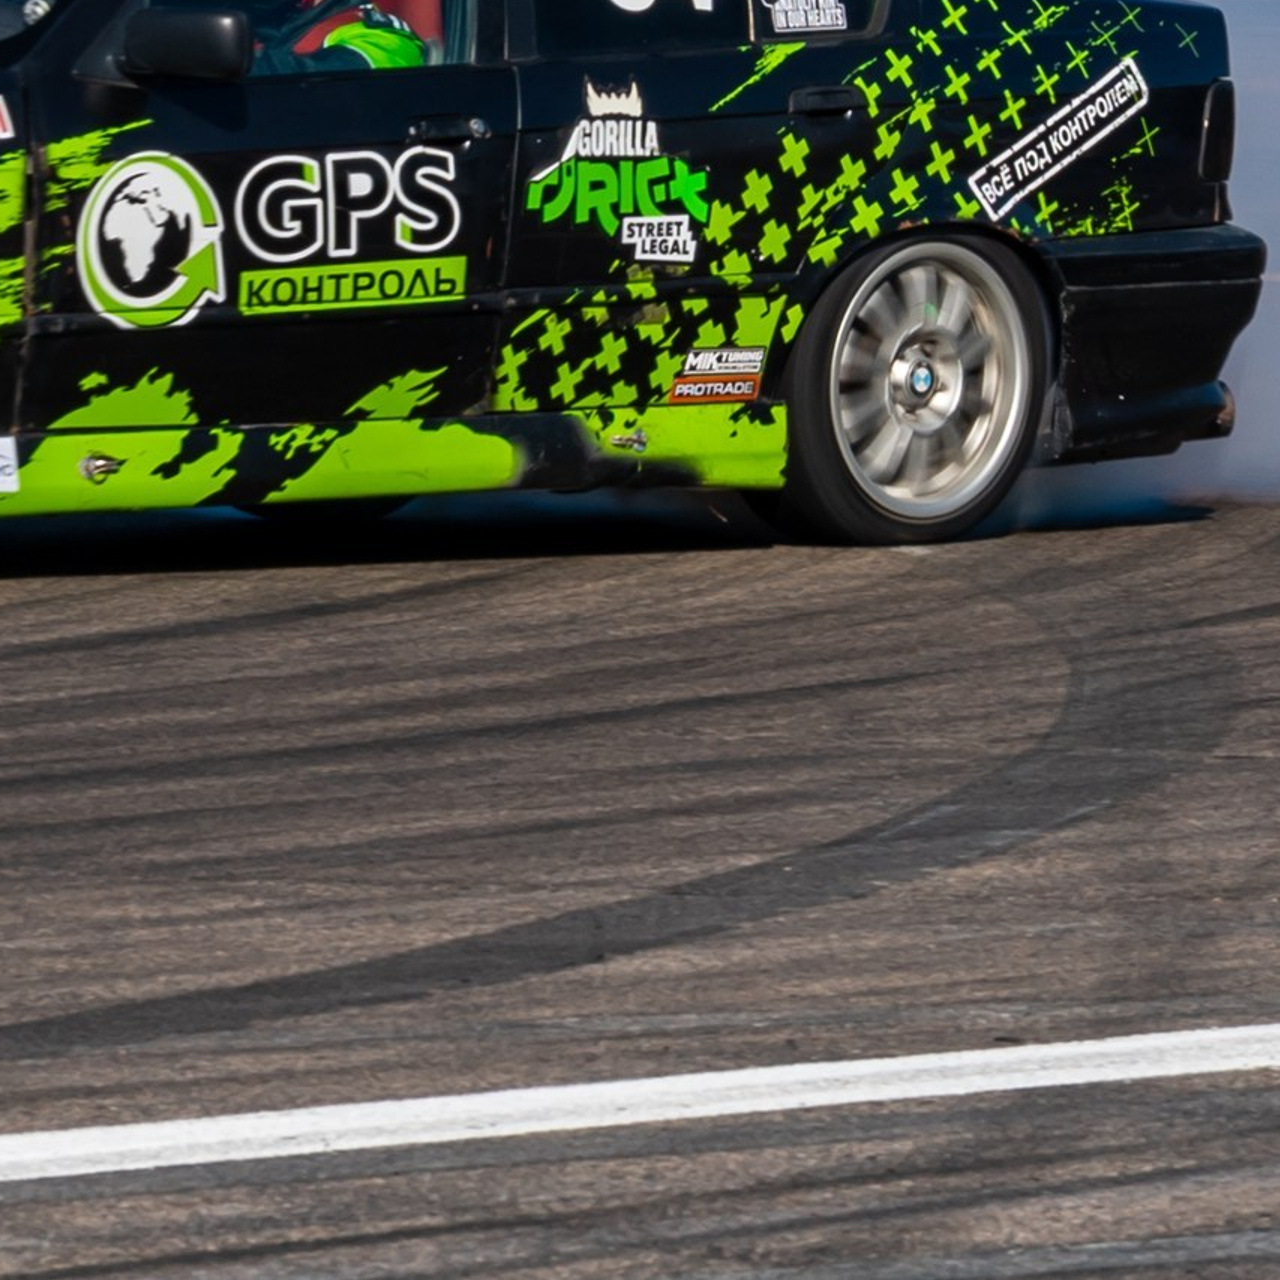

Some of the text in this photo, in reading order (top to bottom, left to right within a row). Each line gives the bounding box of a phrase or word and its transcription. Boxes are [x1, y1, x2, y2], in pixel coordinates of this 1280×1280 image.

[577, 119, 660, 157] GORILLA
[981, 74, 1139, 204] ВСЁ ПОД КОНТРОЛЕМ
[234, 145, 461, 263] GPS
[626, 221, 683, 239] STREET
[640, 239, 690, 255] LEGAL
[246, 267, 458, 308] КОНТРОЛЬ
[674, 381, 755, 397] PROTRADE
